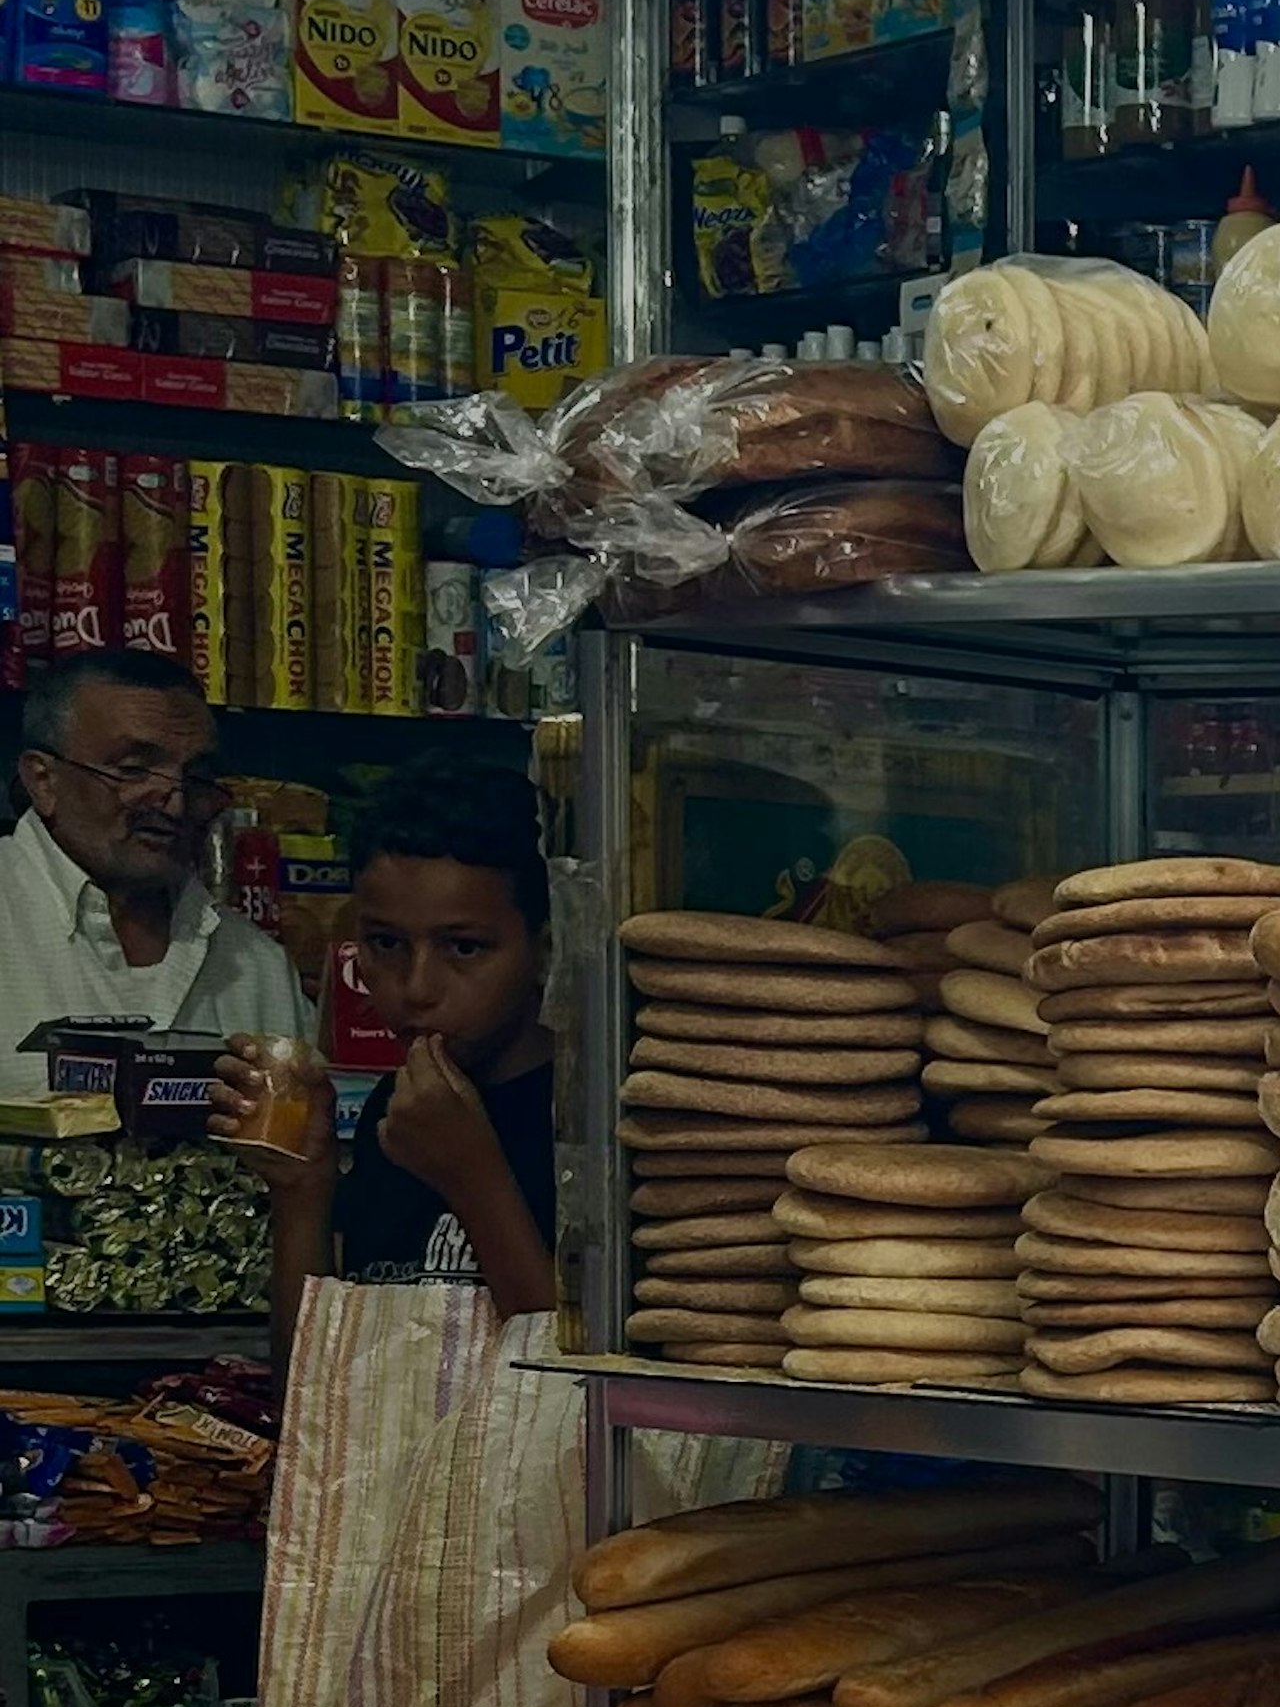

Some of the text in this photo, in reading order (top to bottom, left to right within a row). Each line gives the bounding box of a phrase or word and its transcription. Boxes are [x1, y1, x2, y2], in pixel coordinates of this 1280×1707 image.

[307, 15, 377, 48] NIDO
[408, 30, 478, 62] NIDO
[492, 325, 580, 373] Petit
[373, 540, 395, 705] MEGACHOK
